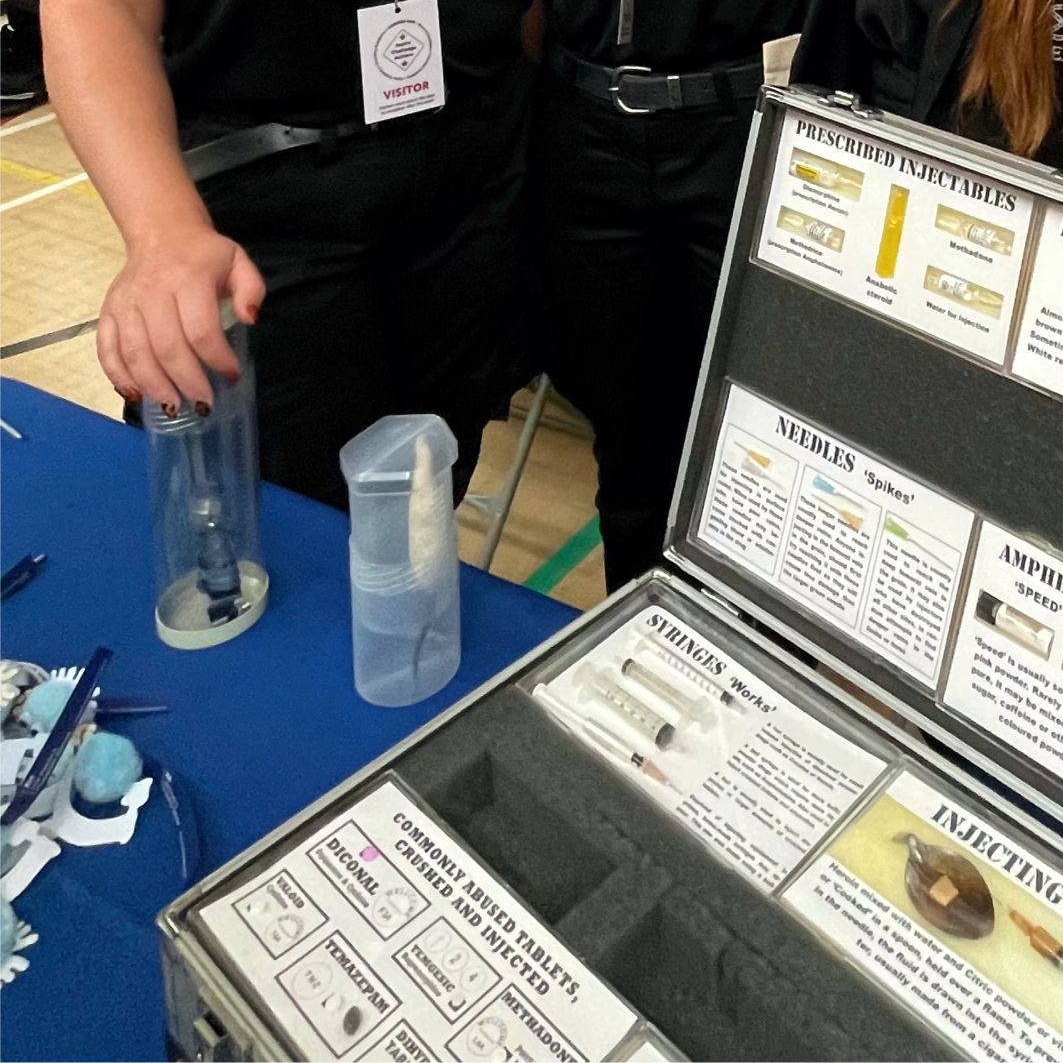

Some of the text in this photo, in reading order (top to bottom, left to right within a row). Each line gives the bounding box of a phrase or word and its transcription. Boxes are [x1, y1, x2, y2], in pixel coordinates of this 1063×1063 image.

[383, 81, 429, 99] VISITOR
[796, 120, 1017, 212] PRESCRIBED INJECTABLES
[775, 415, 855, 472] NEEDLES
[645, 614, 727, 675] SYRINGES
[325, 837, 379, 895] DICONAL
[392, 812, 466, 882] COMMONLY
[461, 879, 515, 933] ABUSED
[514, 929, 580, 1003] TABLETS,
[394, 839, 453, 897] CRUSHED
[450, 896, 482, 926] AND
[479, 924, 549, 995] INJECTED
[320, 938, 390, 1014] TEMAZEPAM
